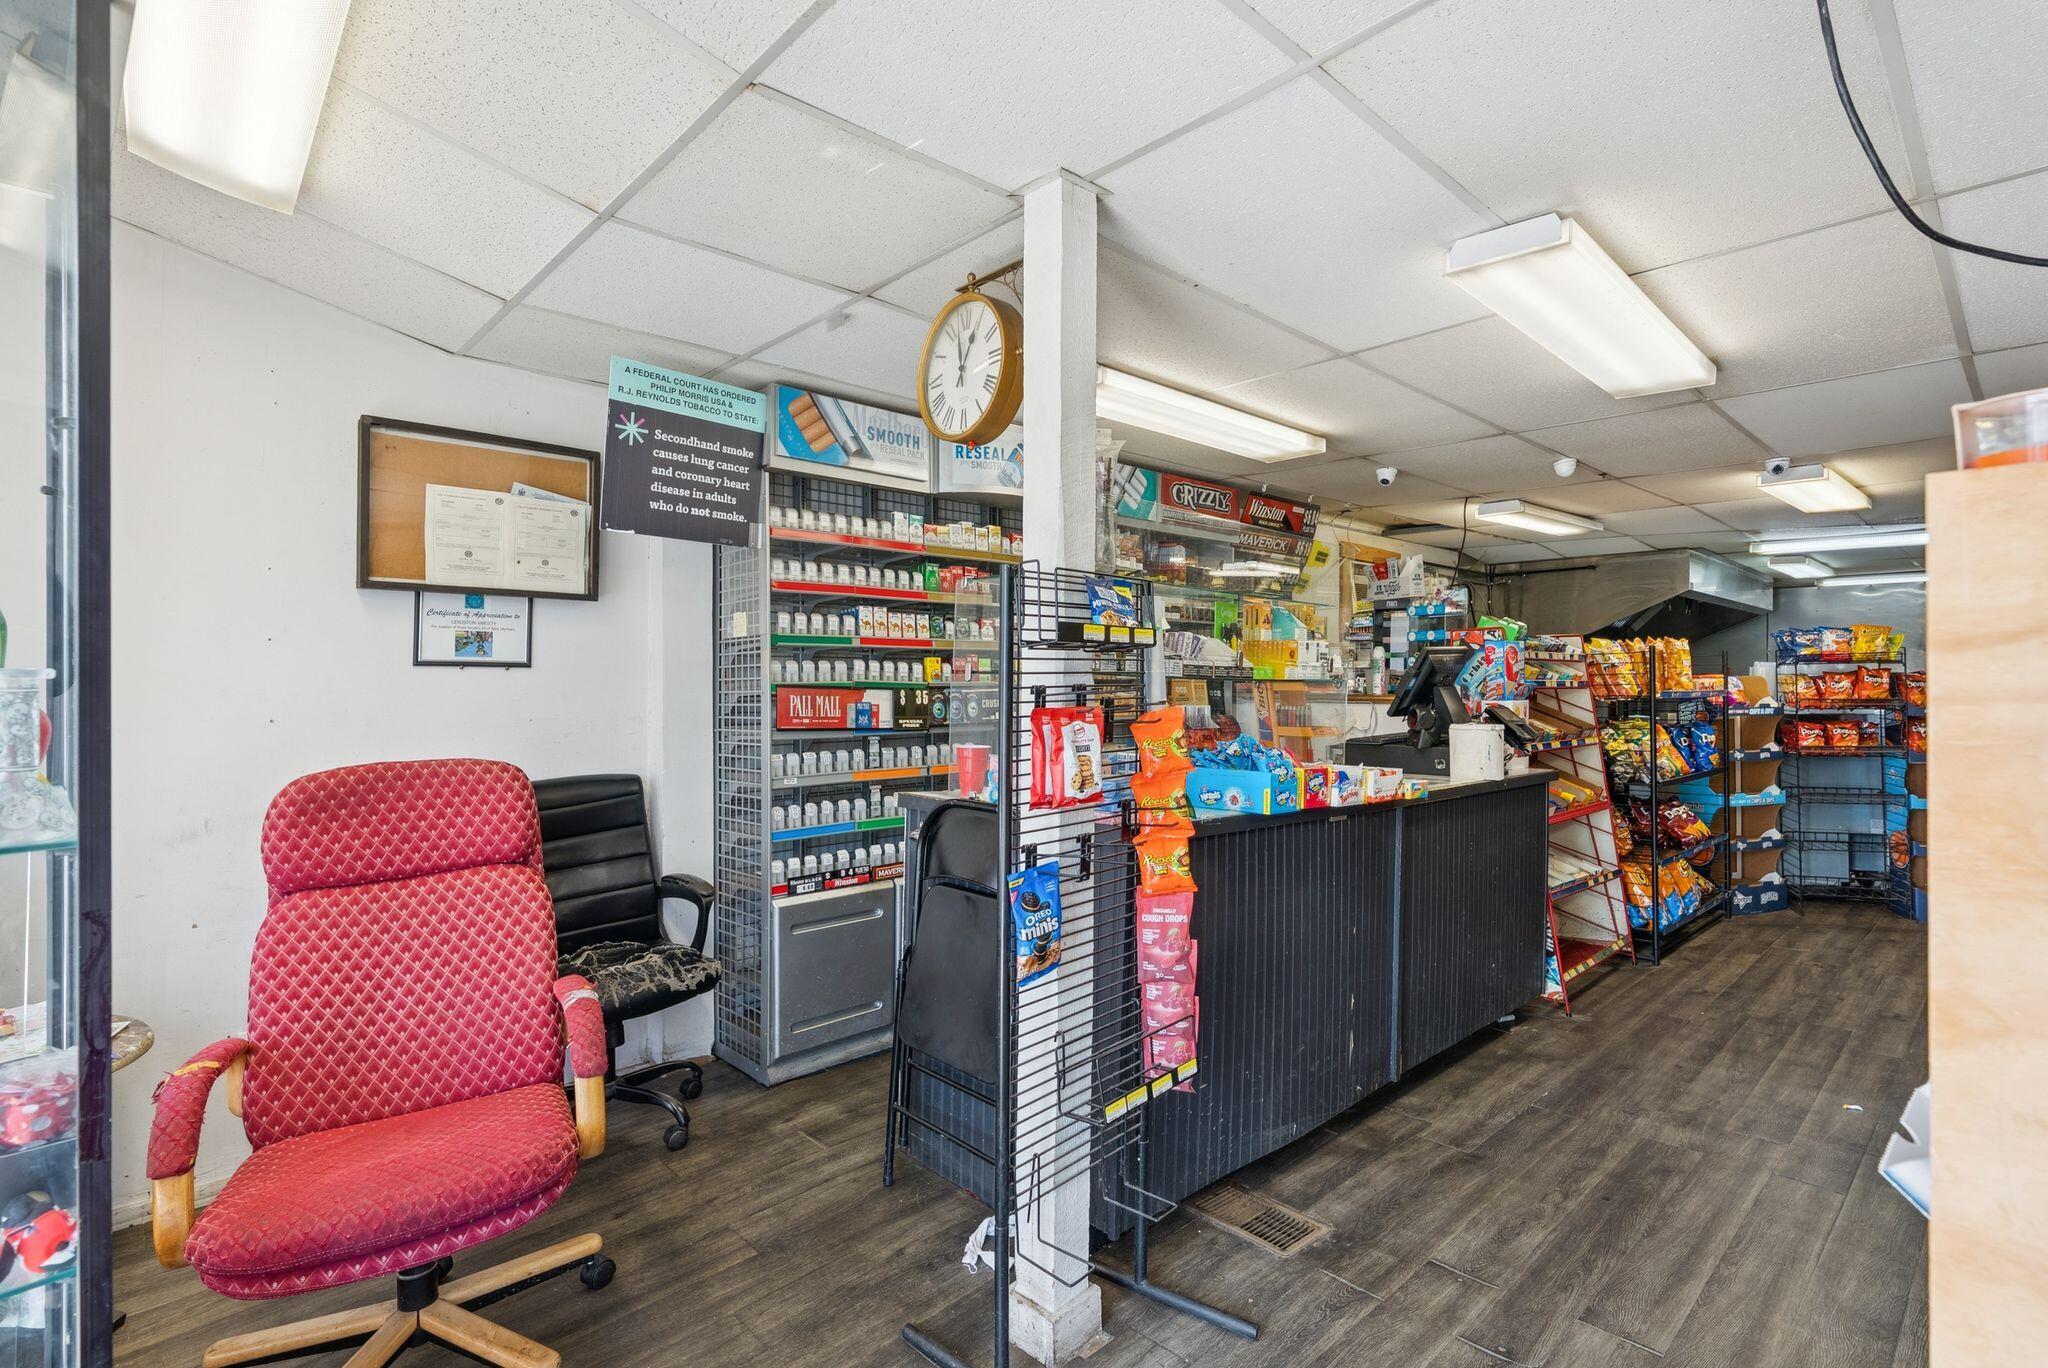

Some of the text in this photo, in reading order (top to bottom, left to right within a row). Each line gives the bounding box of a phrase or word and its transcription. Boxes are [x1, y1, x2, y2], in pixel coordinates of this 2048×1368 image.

[624, 366, 757, 405] A FEDERAL COURT HAS ORDERED
[650, 382, 677, 394] PHILIP
[678, 389, 709, 403] MORRIS
[711, 397, 726, 408] USA
[618, 385, 759, 424] R.J. REYNOLDS TOBACCO TO STATE:
[654, 429, 754, 459] Secondhand smoke
[867, 426, 920, 450] SMOOTH
[653, 448, 750, 474] causes lung cancer
[880, 444, 906, 458] RESEAL
[907, 450, 926, 460] PACK
[956, 445, 1008, 462] RESEAL
[971, 460, 1004, 471] SMOOTH
[652, 466, 750, 491] and coronary heart
[650, 482, 737, 505] disease in adults
[1172, 484, 1230, 512] GRIZZLY
[650, 500, 748, 522] who do not smoke.
[1249, 499, 1286, 522] Winston
[1240, 533, 1288, 551] MAVERICK
[426, 608, 462, 618] Certificate
[464, 610, 470, 618] of
[472, 611, 512, 620] Appreciation
[790, 694, 841, 717] PALL MALL
[915, 690, 928, 704] 35
[1020, 916, 1060, 941] minis
[1025, 908, 1052, 926] OREO
[1142, 914, 1188, 923] COUGH DROPS
